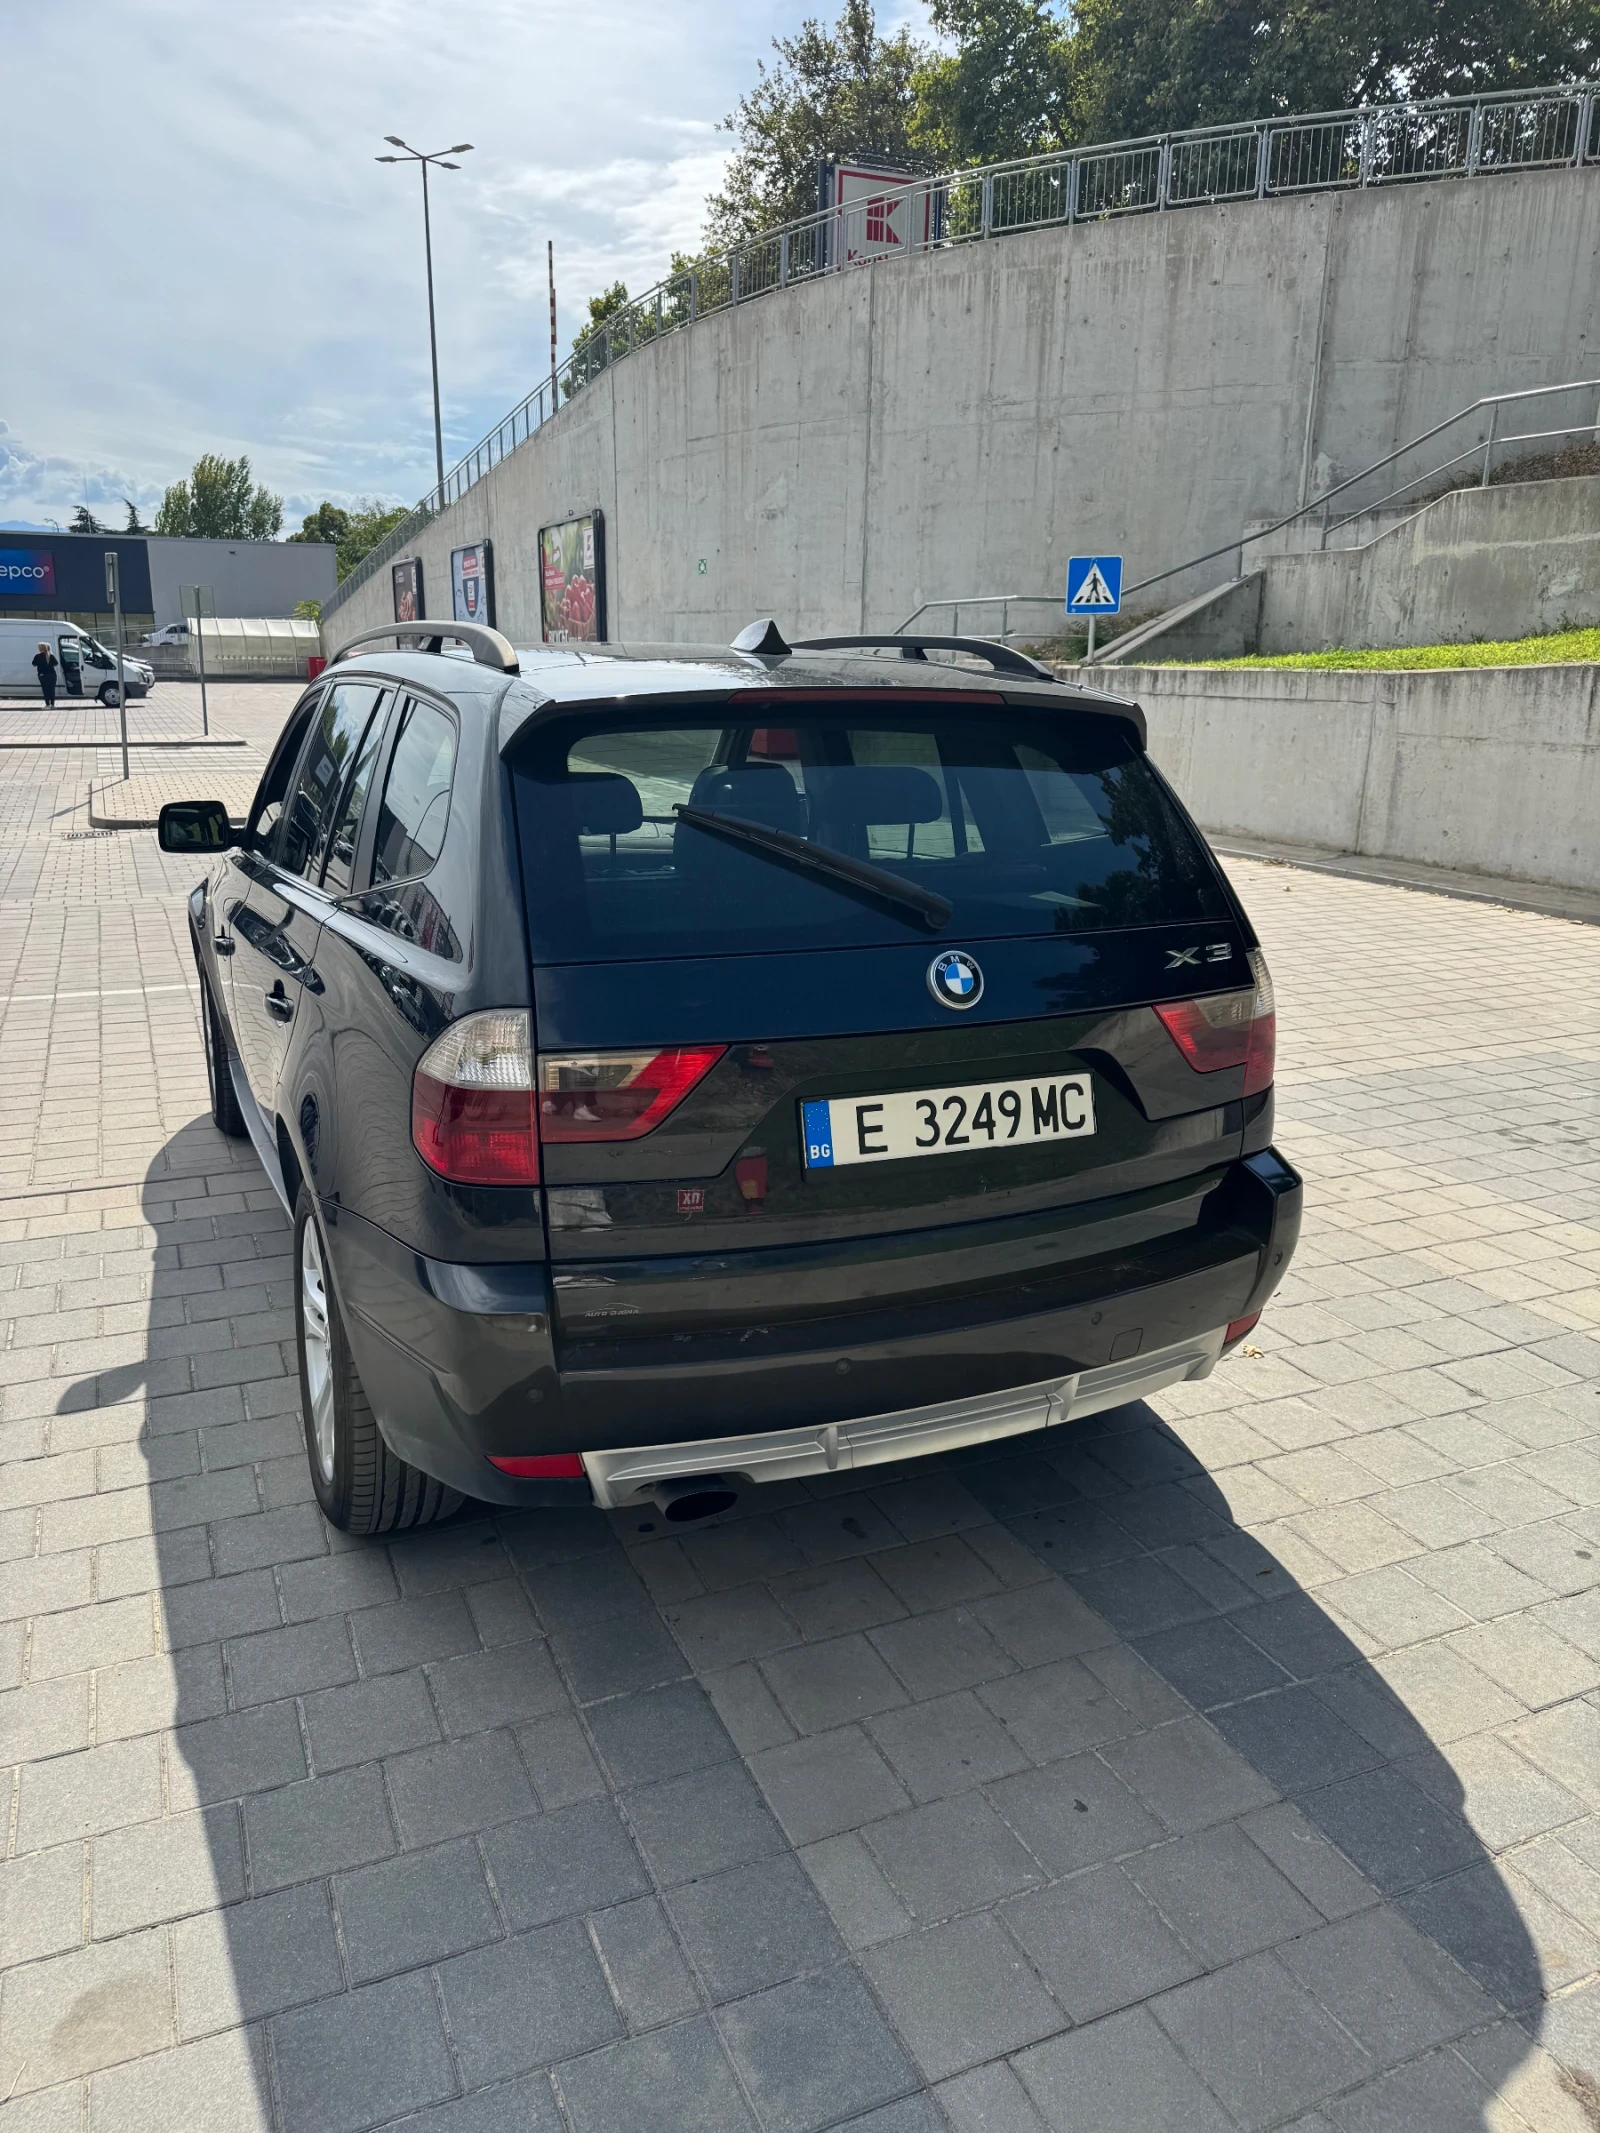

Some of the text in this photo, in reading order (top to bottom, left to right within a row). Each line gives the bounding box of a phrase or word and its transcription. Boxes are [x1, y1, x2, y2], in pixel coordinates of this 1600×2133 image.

[938, 955, 975, 972] BMW
[855, 1082, 1086, 1155] E 3249 MC
[809, 1143, 831, 1160] BG
